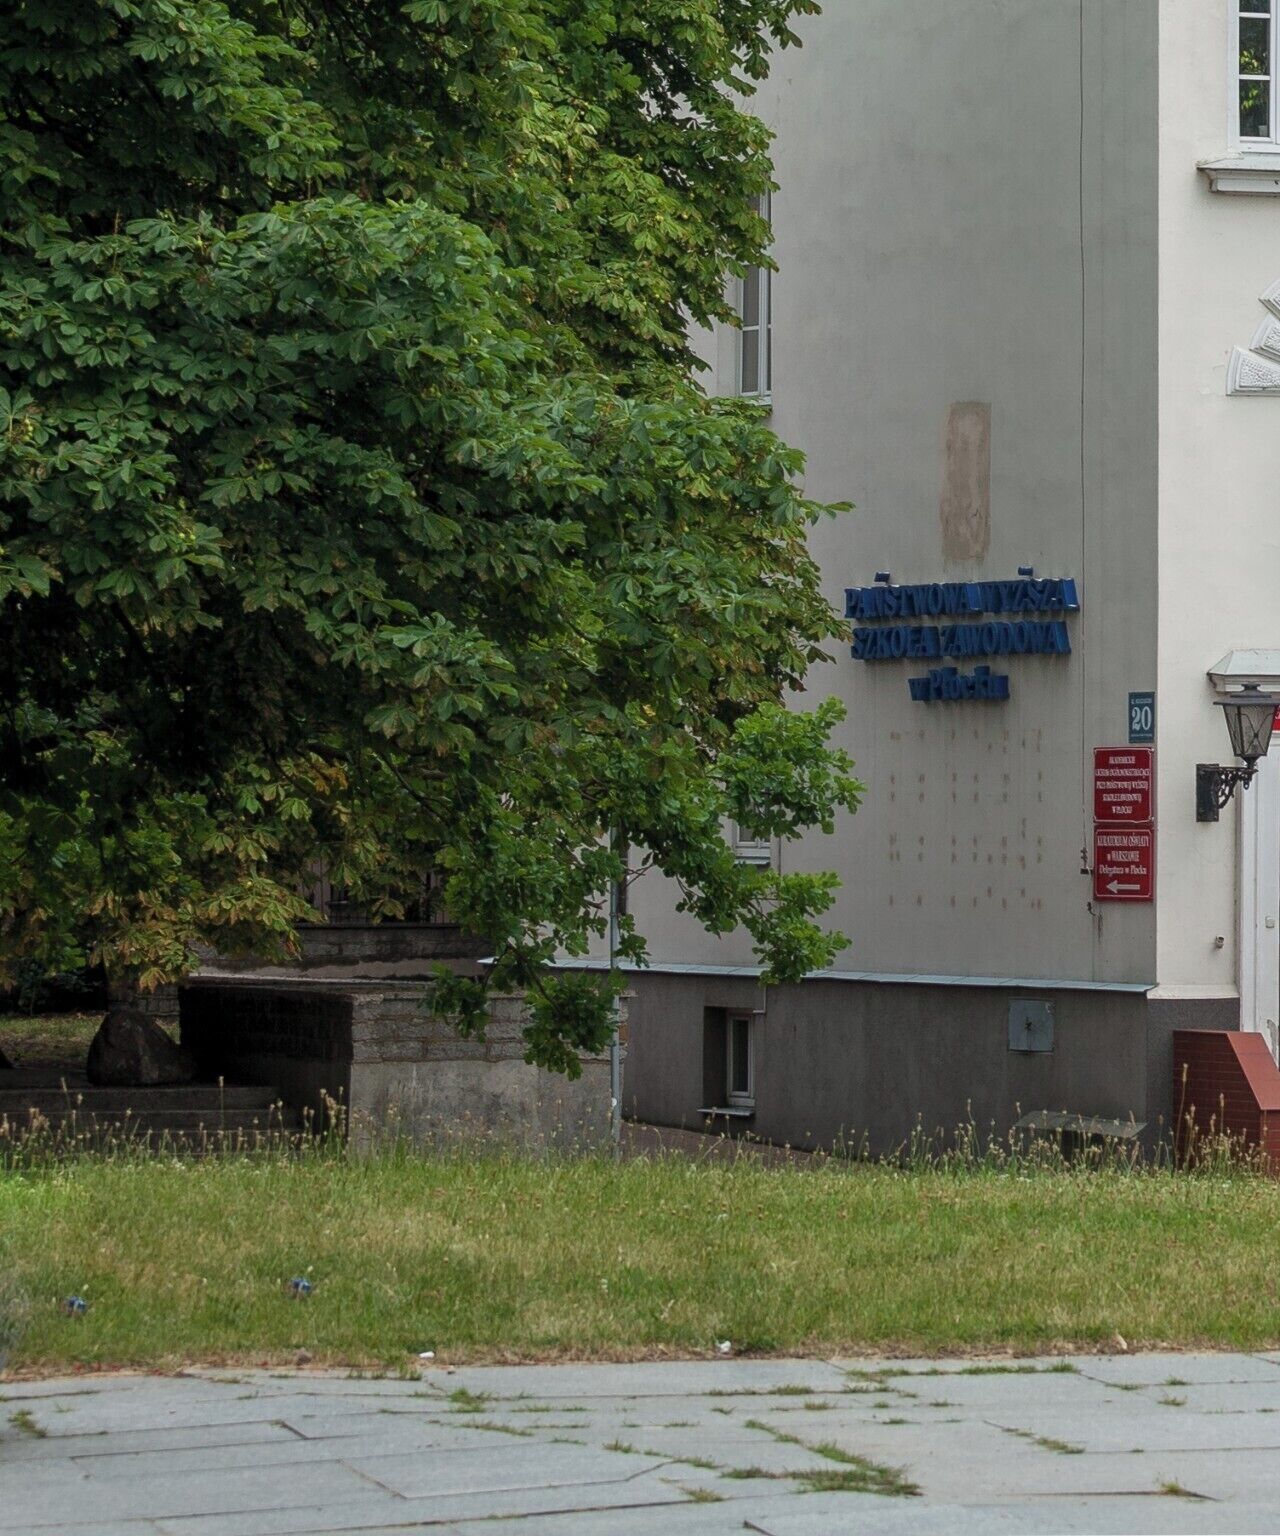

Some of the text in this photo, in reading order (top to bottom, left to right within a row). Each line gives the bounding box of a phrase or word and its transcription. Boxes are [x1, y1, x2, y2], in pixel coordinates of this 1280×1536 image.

[851, 621, 1071, 660] SZKOŁA ZAWODOWA
[1131, 705, 1152, 731] 20
